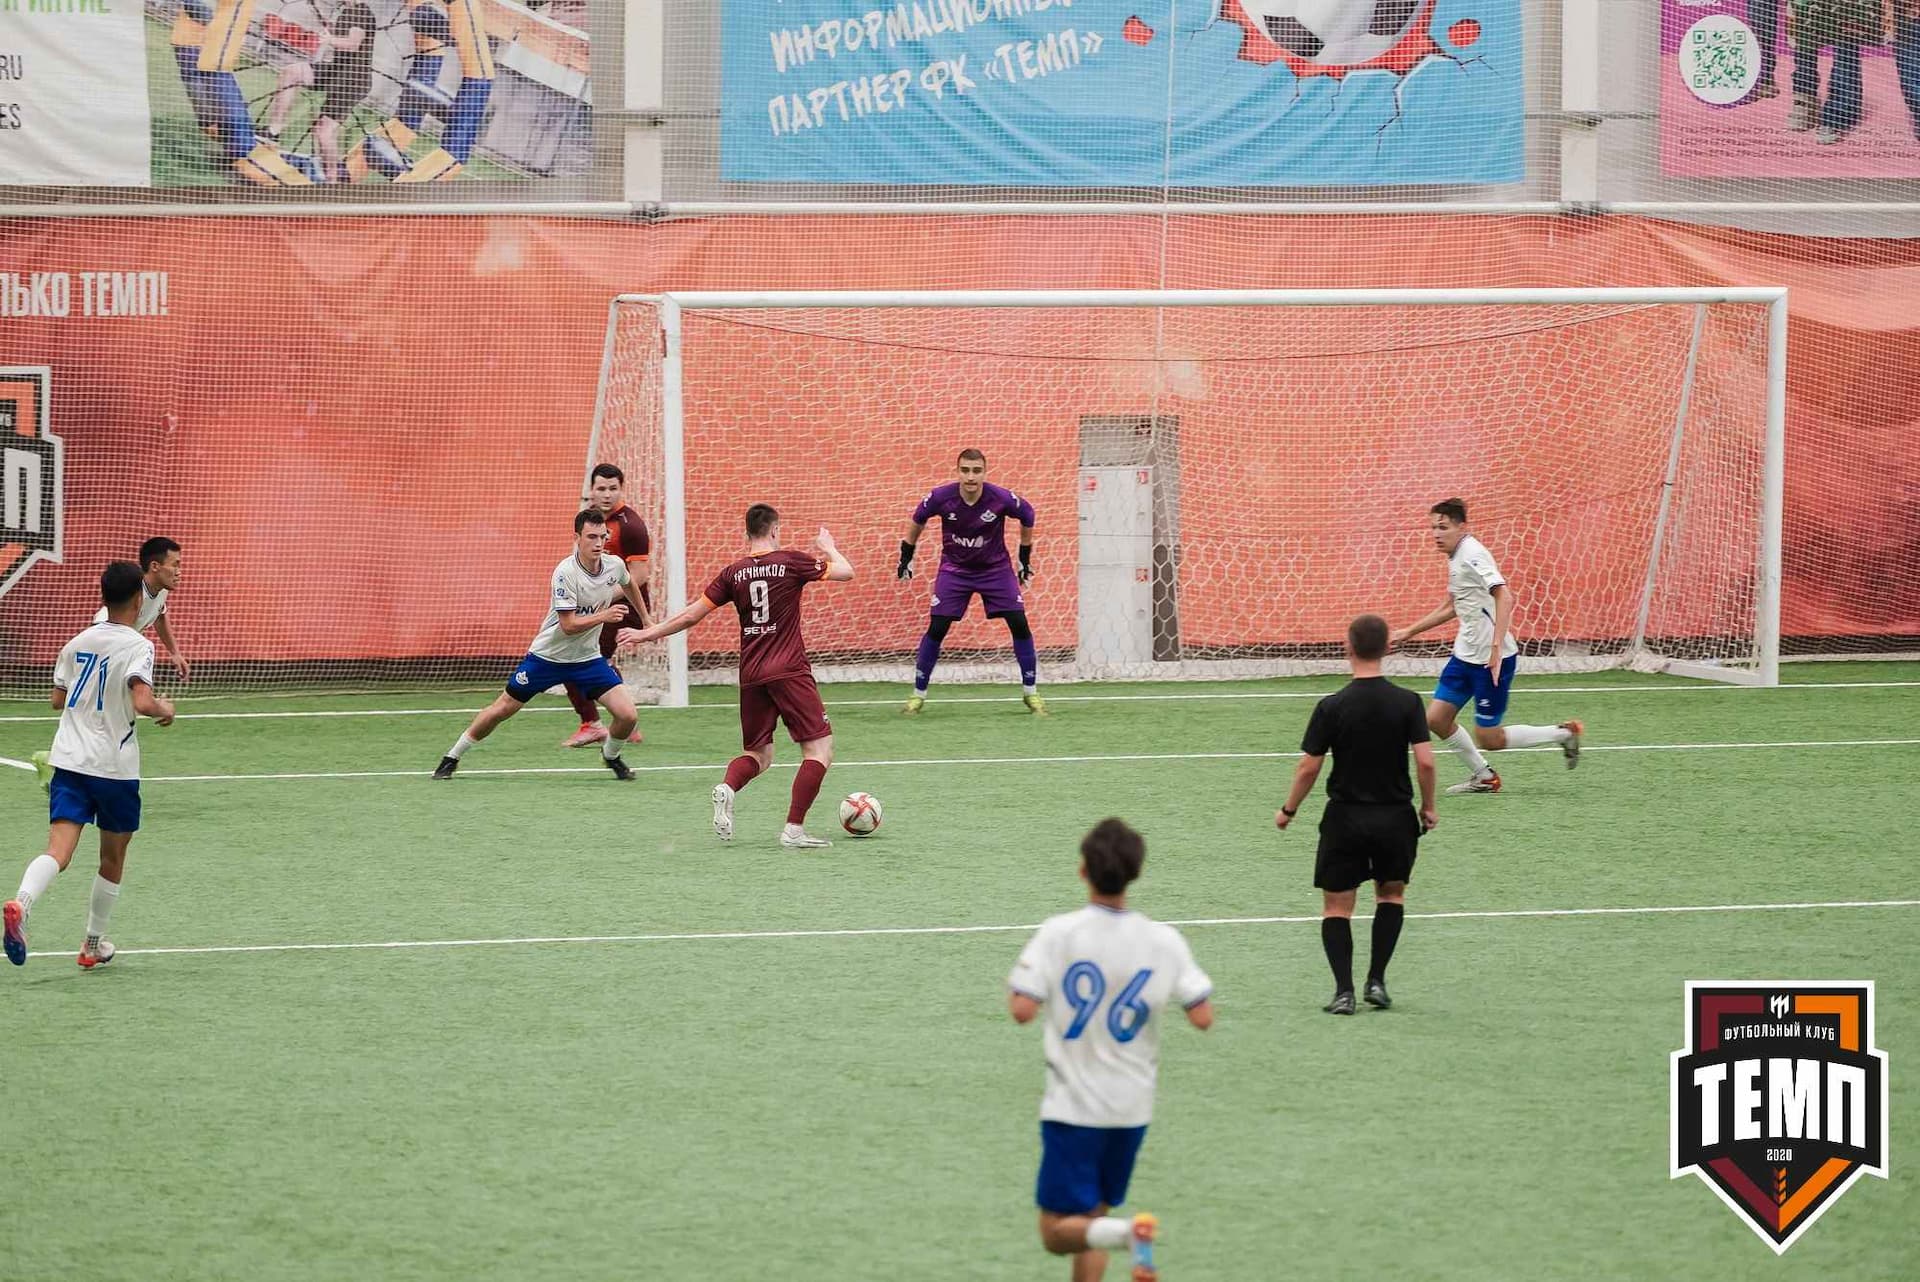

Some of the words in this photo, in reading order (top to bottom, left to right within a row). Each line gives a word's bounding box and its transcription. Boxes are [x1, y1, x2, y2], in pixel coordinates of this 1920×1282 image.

[770, 0, 1072, 73] ИНФОРМАЦИОН
[767, 69, 911, 136] ПАРТНЕР
[920, 54, 976, 100] ФК
[983, 28, 1104, 84] «ТЕМП»
[80, 271, 169, 317] ТЕМП!
[749, 580, 770, 624] 9
[67, 651, 110, 711] 71
[1062, 960, 1153, 1043] 96
